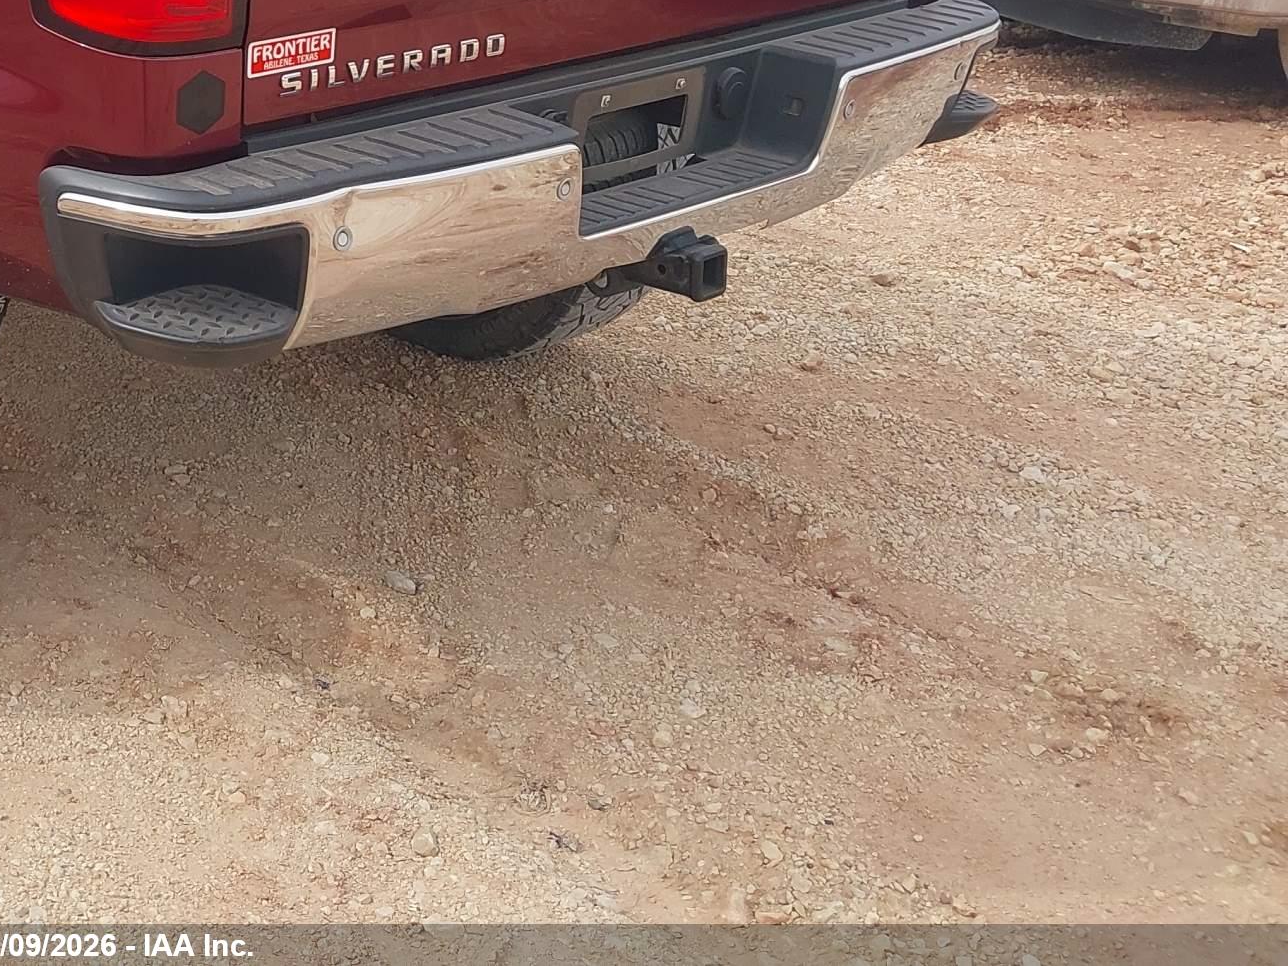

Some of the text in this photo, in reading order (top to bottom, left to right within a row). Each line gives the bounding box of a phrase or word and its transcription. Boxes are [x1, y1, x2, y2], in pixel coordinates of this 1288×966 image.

[253, 34, 331, 63] FRONTIER
[297, 52, 319, 63] TEXAS
[279, 33, 506, 97] SILVERADO
